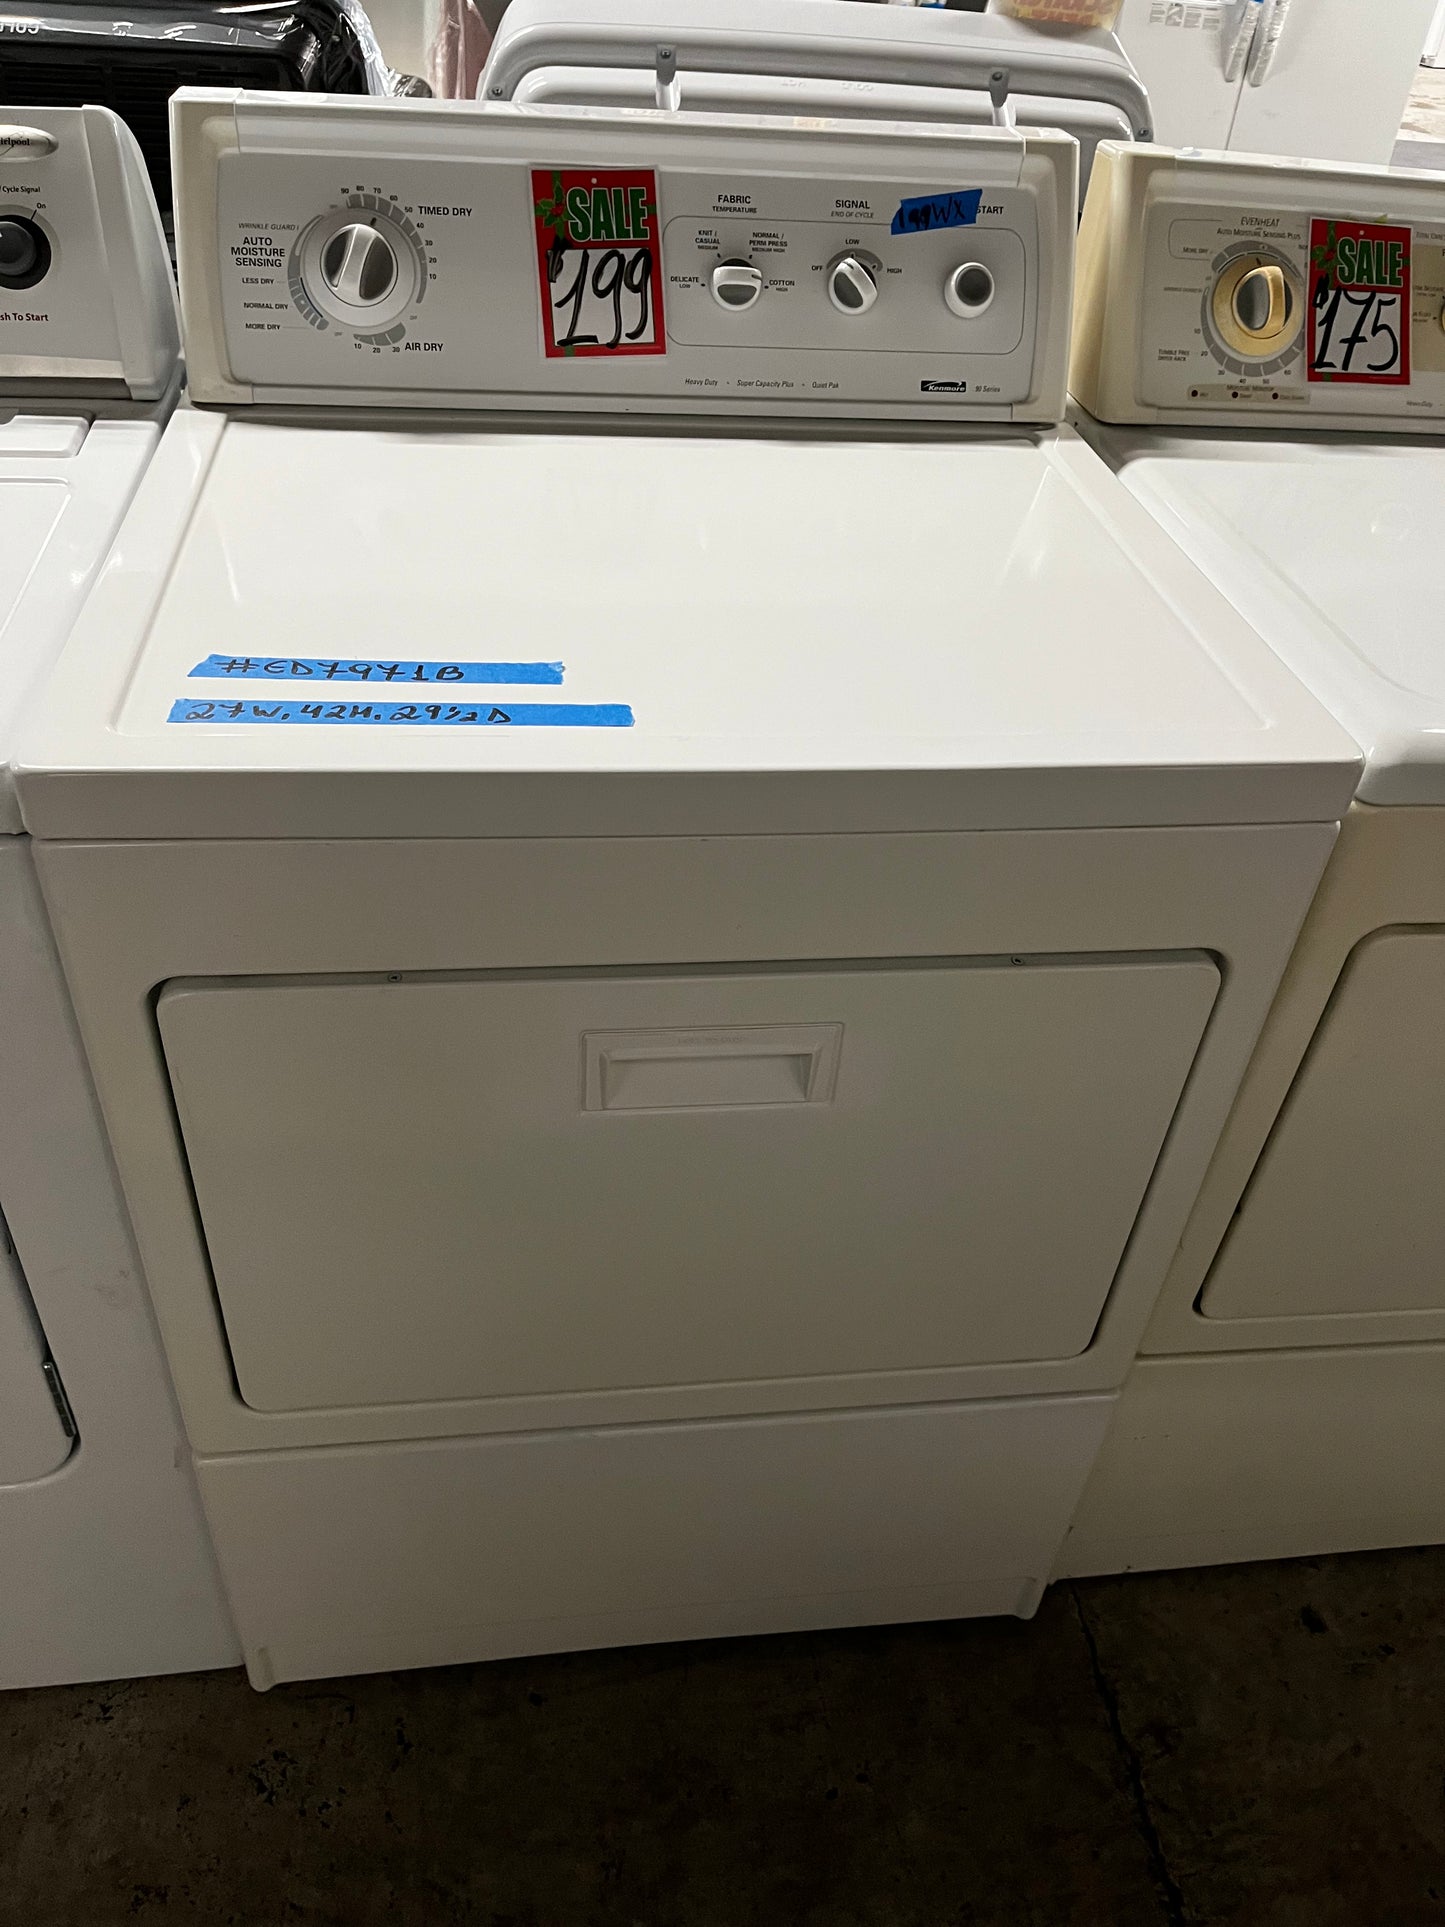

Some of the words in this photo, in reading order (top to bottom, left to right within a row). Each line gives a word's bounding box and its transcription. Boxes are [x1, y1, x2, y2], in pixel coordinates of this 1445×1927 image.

[2, 185, 20, 193] Cycle
[20, 185, 41, 194] Signal
[717, 194, 752, 204] FABRIC
[712, 205, 758, 214] TEMPERATURE
[835, 199, 870, 210] SIGNAL
[417, 206, 450, 216] TIMED
[451, 207, 473, 217] DRY
[566, 186, 650, 243] SALE
[270, 223, 296, 231] GUARD
[1241, 217, 1280, 227] EVENHEAT
[243, 236, 273, 246] AUTO
[230, 246, 286, 257] MOISTURE
[235, 257, 282, 268] SENSING
[428, 257, 438, 265] 20
[1337, 237, 1404, 288] SALE
[241, 277, 259, 285] LESS
[429, 273, 437, 281] 10
[243, 302, 273, 310] NORMAL
[12, 312, 25, 321] To
[26, 313, 49, 321] Start
[354, 342, 362, 350] 10
[404, 342, 421, 351] AIR
[423, 342, 444, 352] DRY
[685, 378, 703, 386] Heavy
[737, 379, 754, 388] Super
[755, 380, 780, 388] Capacity
